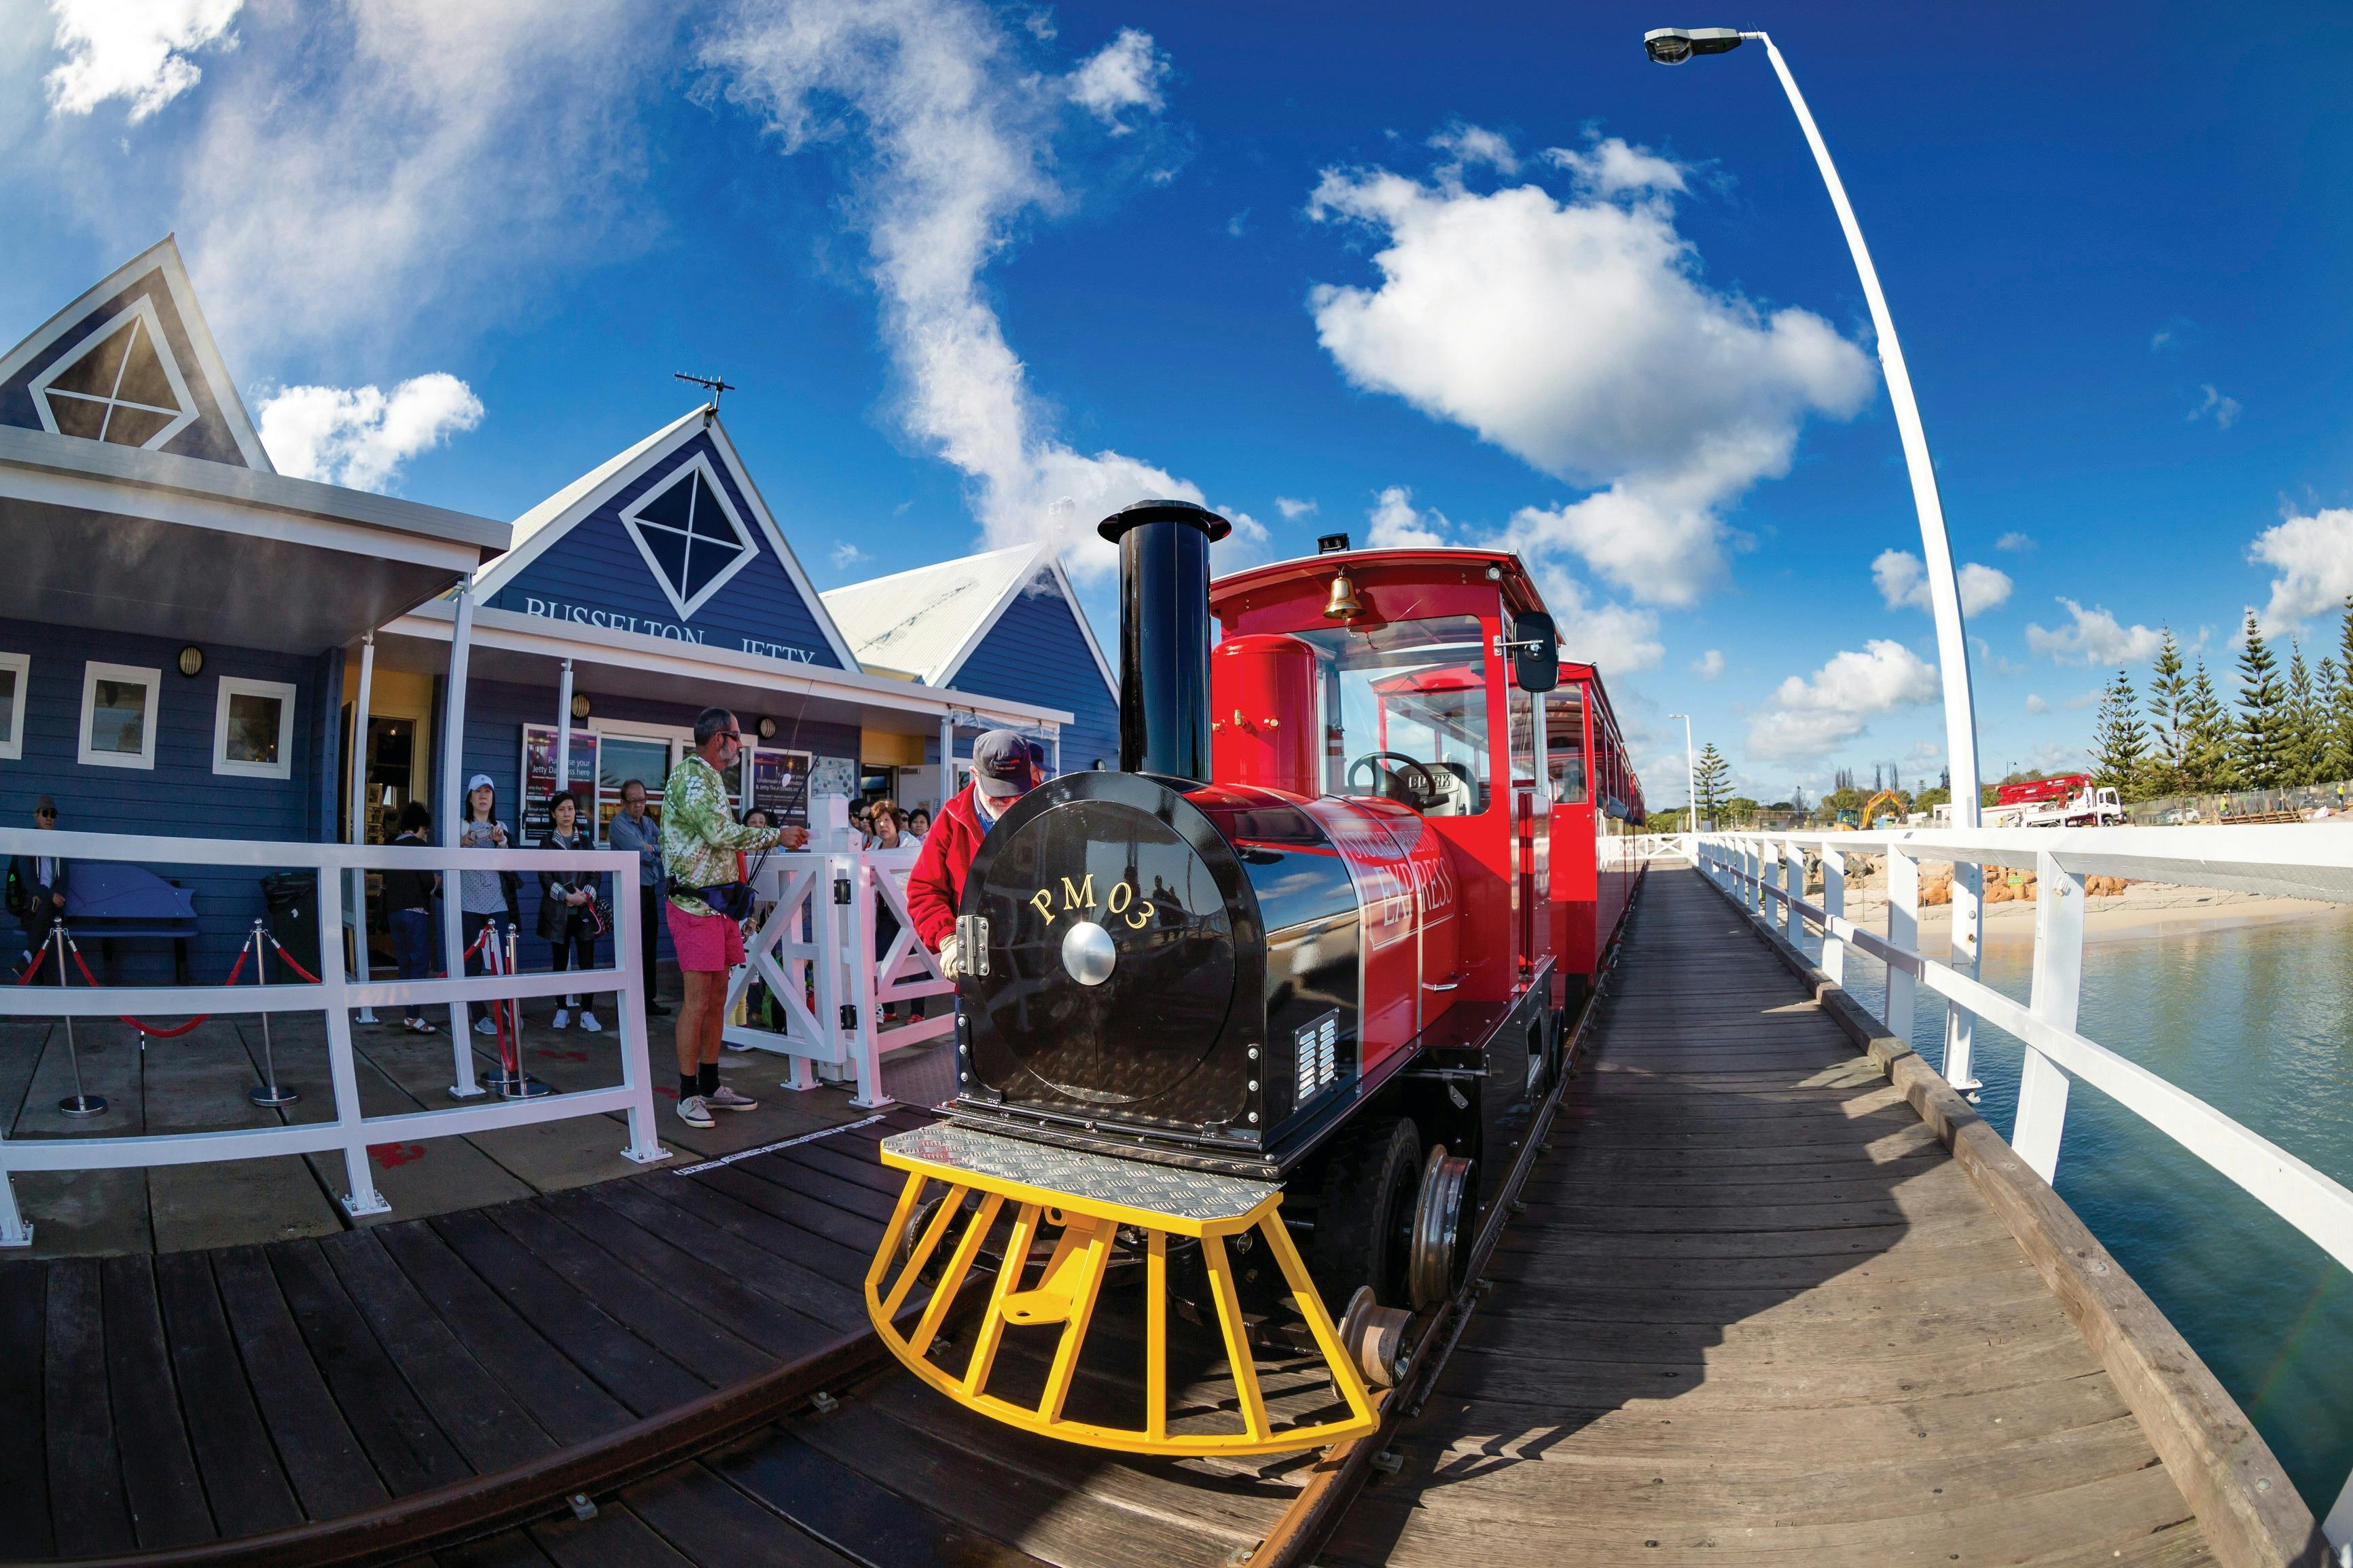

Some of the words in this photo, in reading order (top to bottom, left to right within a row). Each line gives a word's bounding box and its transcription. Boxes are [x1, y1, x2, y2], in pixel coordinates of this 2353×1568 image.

[533, 765, 547, 775] Jetty
[1409, 775, 1451, 788] CLRK
[1373, 857, 1453, 926] EXPRESS
